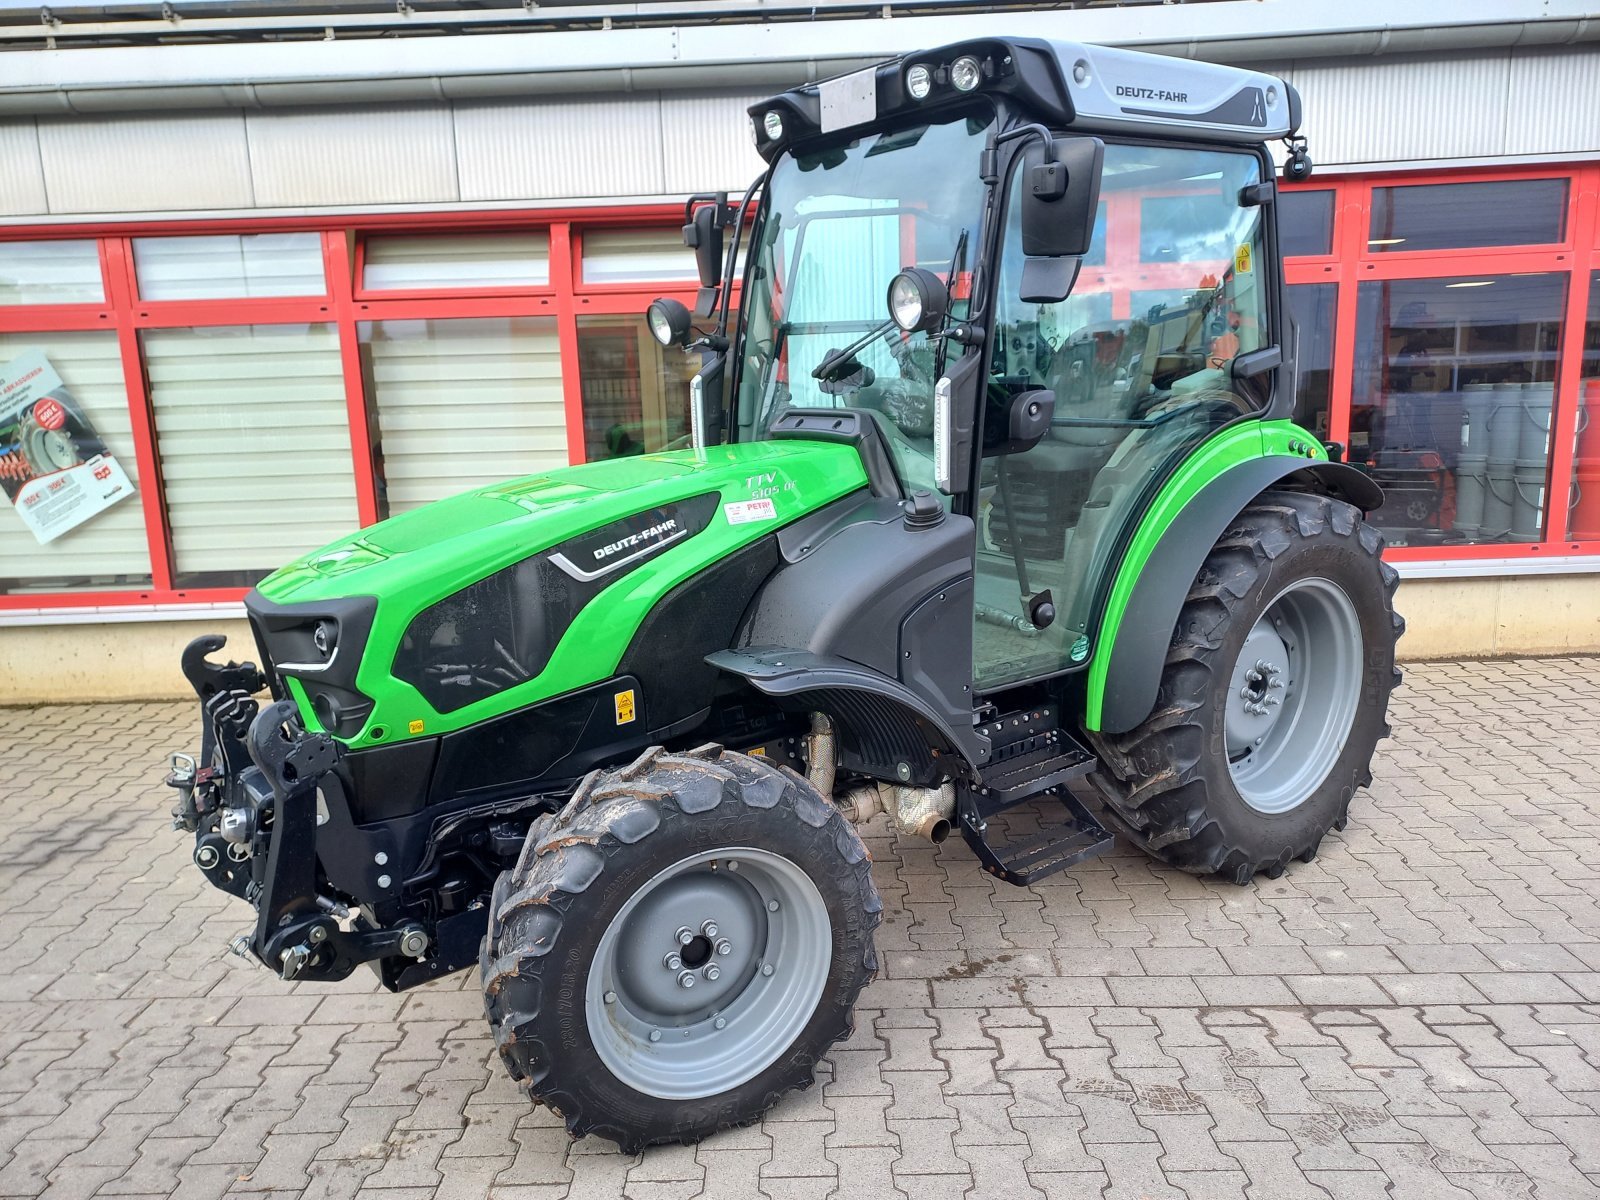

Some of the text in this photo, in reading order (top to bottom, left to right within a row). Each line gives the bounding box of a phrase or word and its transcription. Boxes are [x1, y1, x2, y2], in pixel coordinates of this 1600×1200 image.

[1115, 85, 1188, 103] DEUTZ-FAHR
[746, 471, 778, 489] TTV
[593, 519, 677, 560] DEUTZ-FAHR
